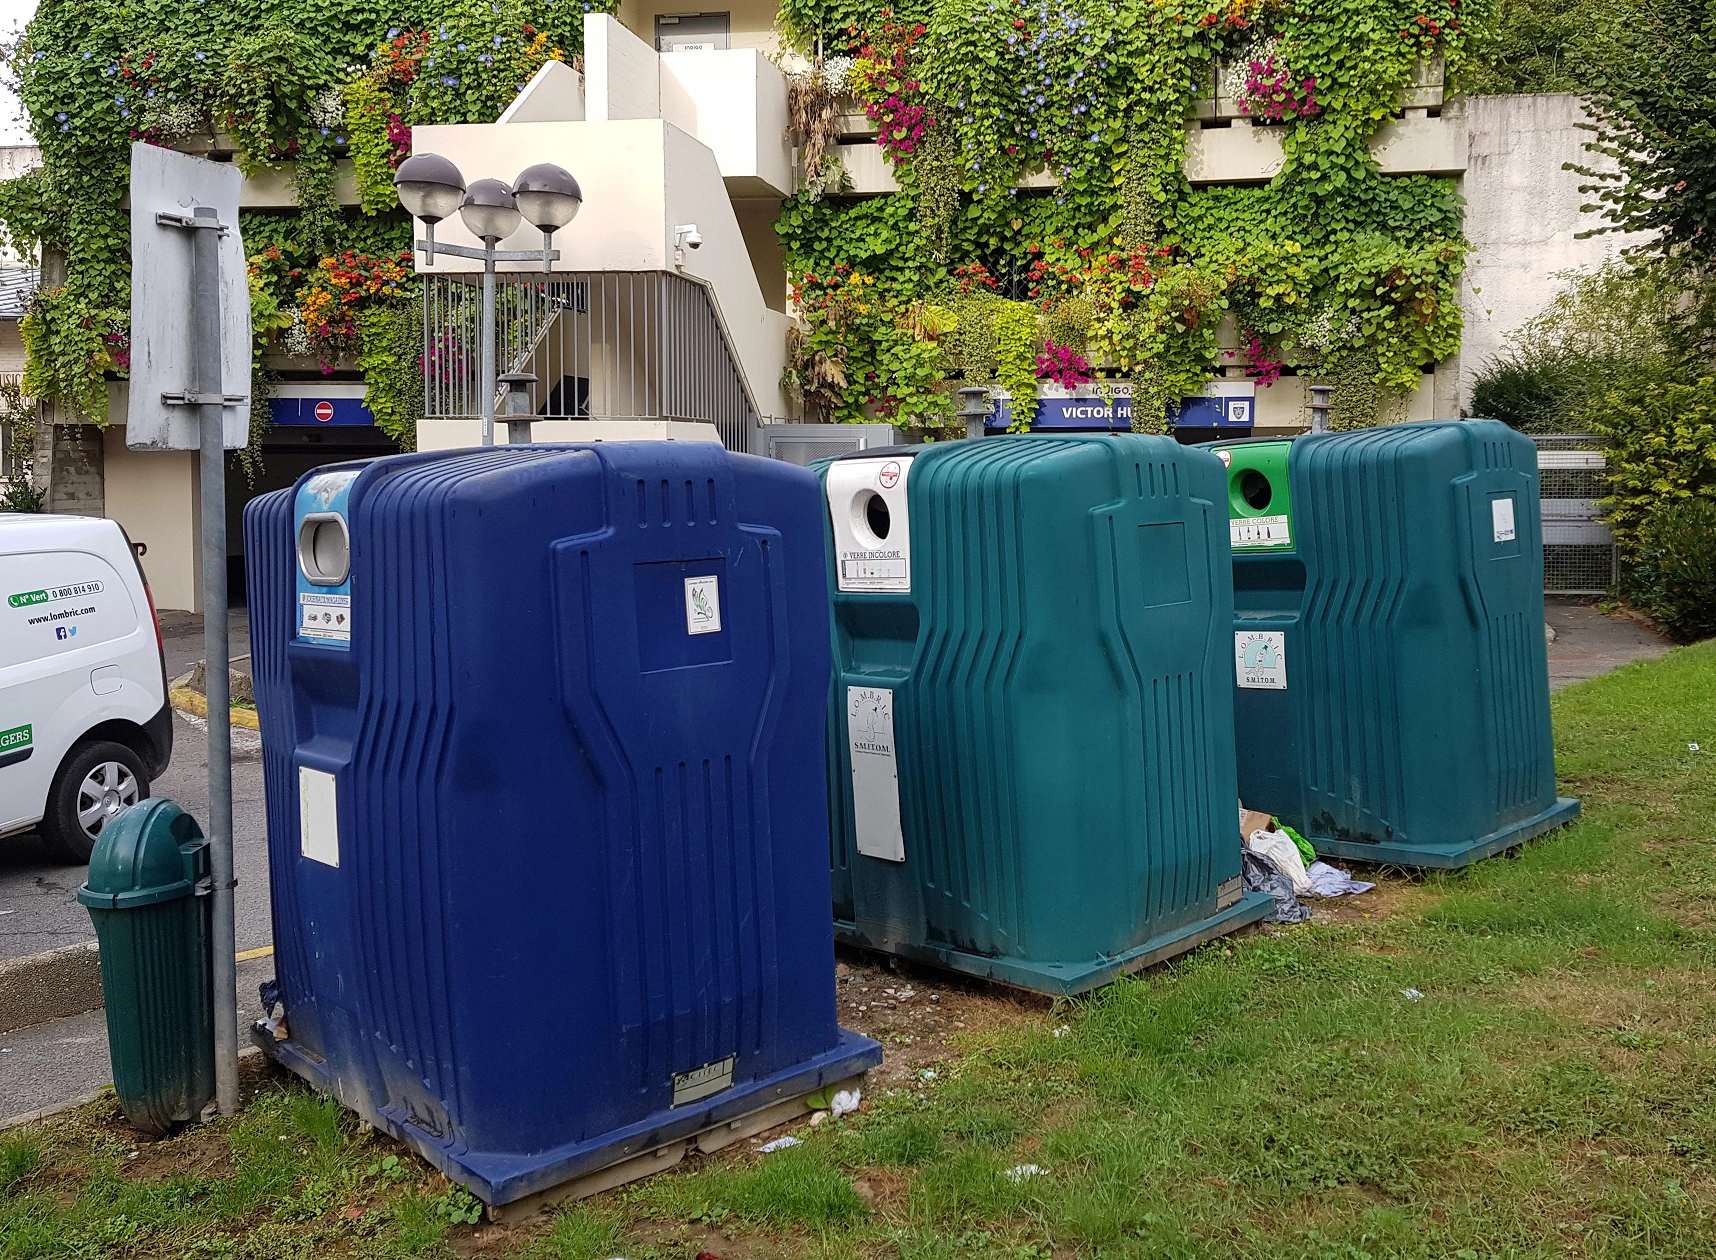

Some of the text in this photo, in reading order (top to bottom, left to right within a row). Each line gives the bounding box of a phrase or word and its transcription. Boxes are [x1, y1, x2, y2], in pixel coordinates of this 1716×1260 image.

[1062, 406, 1114, 418] VICTOR
[849, 550, 901, 559] VERRE INCOLORE
[30, 592, 47, 602] Vert
[52, 590, 58, 598] 0
[59, 587, 72, 597] 800
[74, 585, 86, 595] 814
[87, 583, 100, 592] 910
[27, 606, 96, 626] www.lombric.com
[0, 729, 30, 746] GERS
